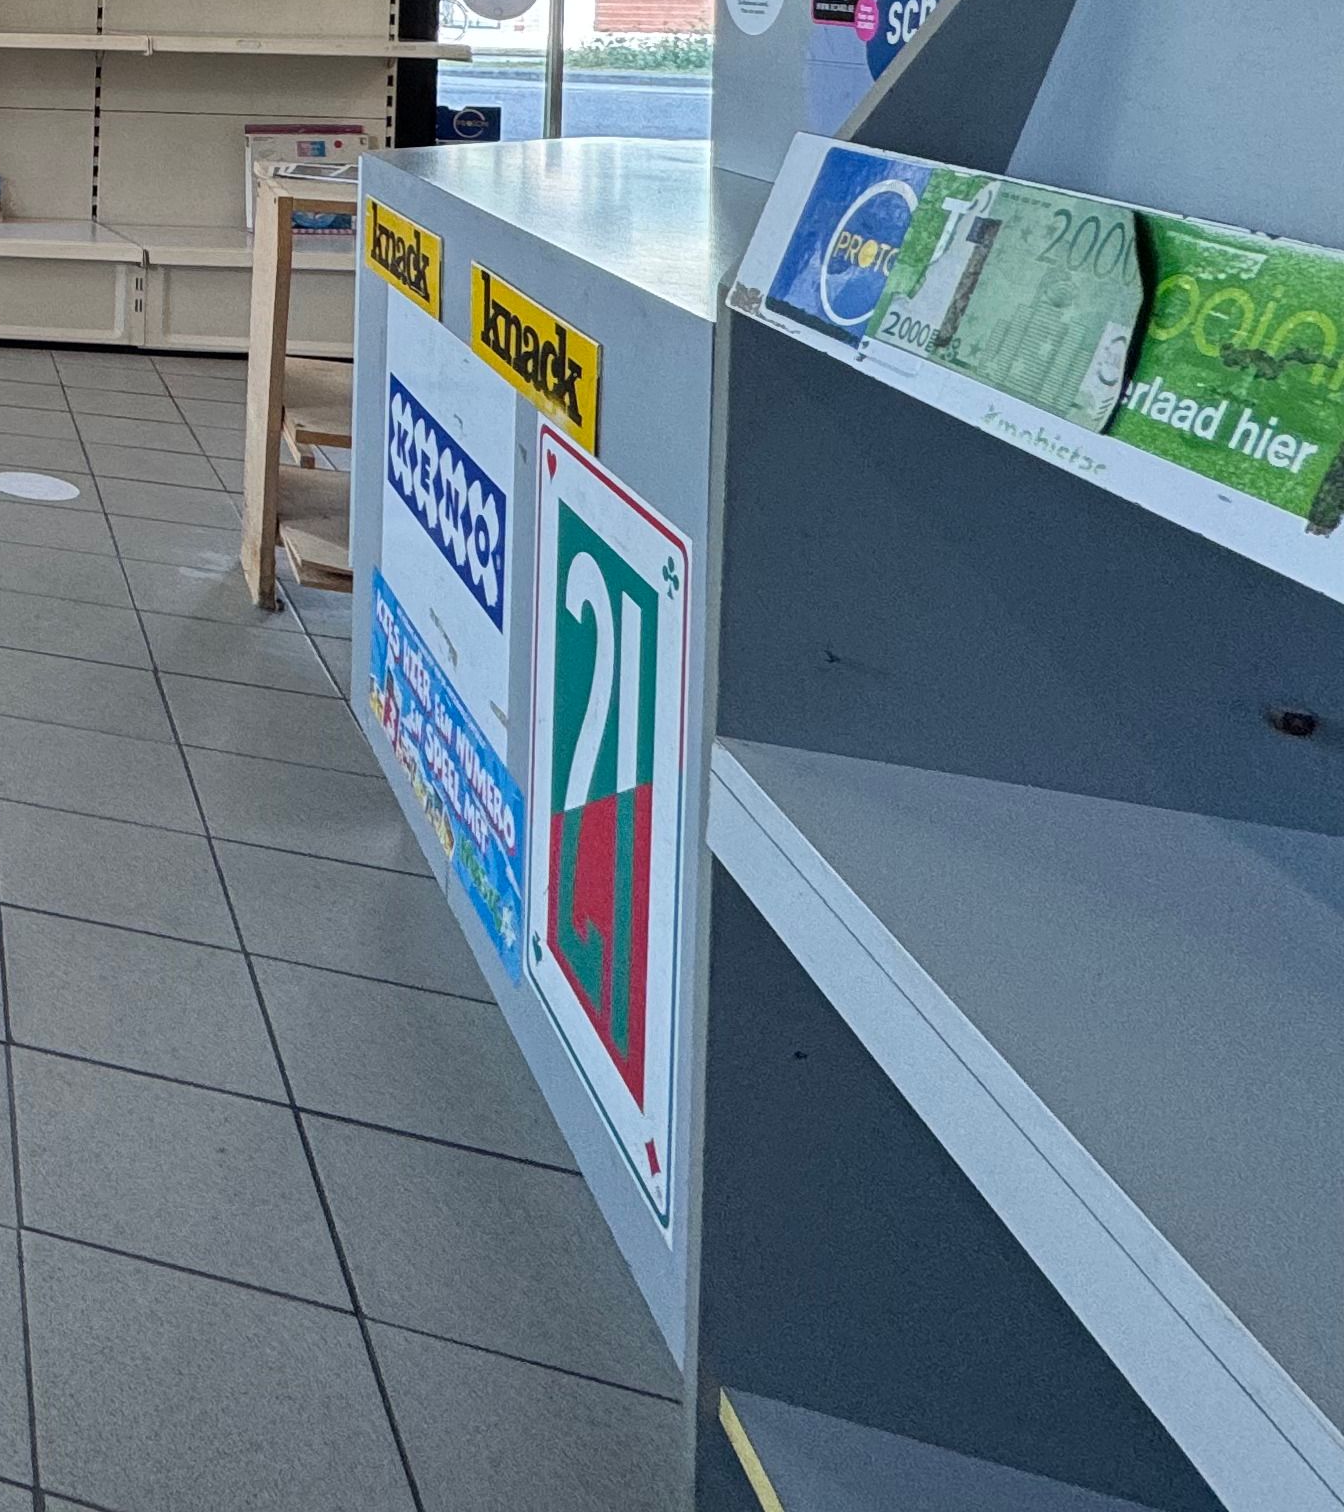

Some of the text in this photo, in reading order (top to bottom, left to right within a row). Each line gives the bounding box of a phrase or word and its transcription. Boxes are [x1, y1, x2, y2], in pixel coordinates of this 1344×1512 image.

[370, 203, 430, 304] knack
[480, 268, 584, 427] knack
[389, 390, 502, 609] KENO
[1227, 407, 1320, 474] hier
[403, 636, 432, 718] HIER
[455, 724, 516, 856] NUMERO
[423, 723, 462, 822] SPEEL
